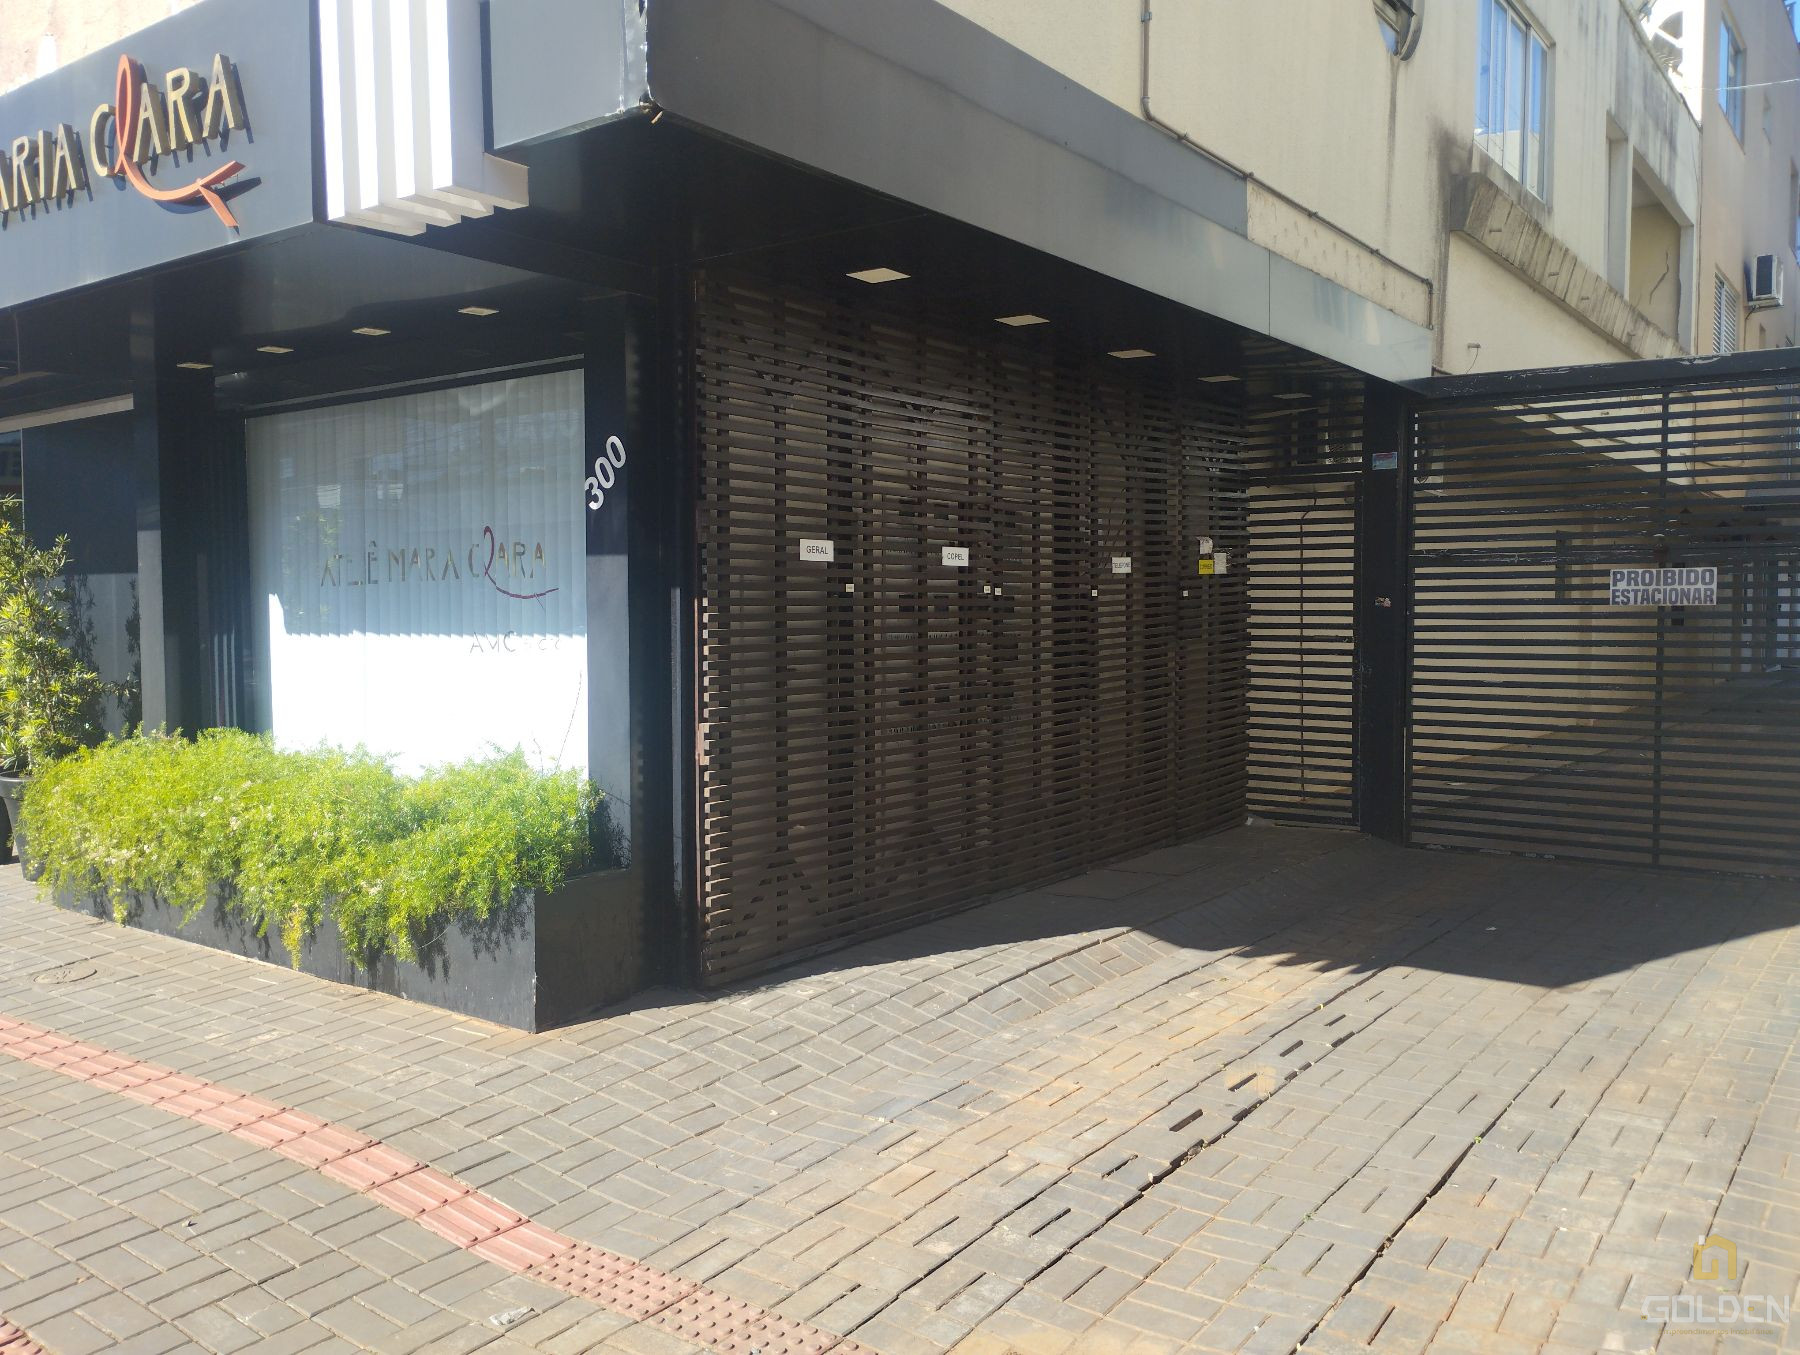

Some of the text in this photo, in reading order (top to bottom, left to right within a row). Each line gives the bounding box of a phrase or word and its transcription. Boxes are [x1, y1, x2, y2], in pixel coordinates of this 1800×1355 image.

[584, 436, 627, 510] 300
[806, 545, 829, 555] GERAL
[1612, 569, 1715, 587] PROIBIDO
[1611, 588, 1715, 605] ESTACIONAR
